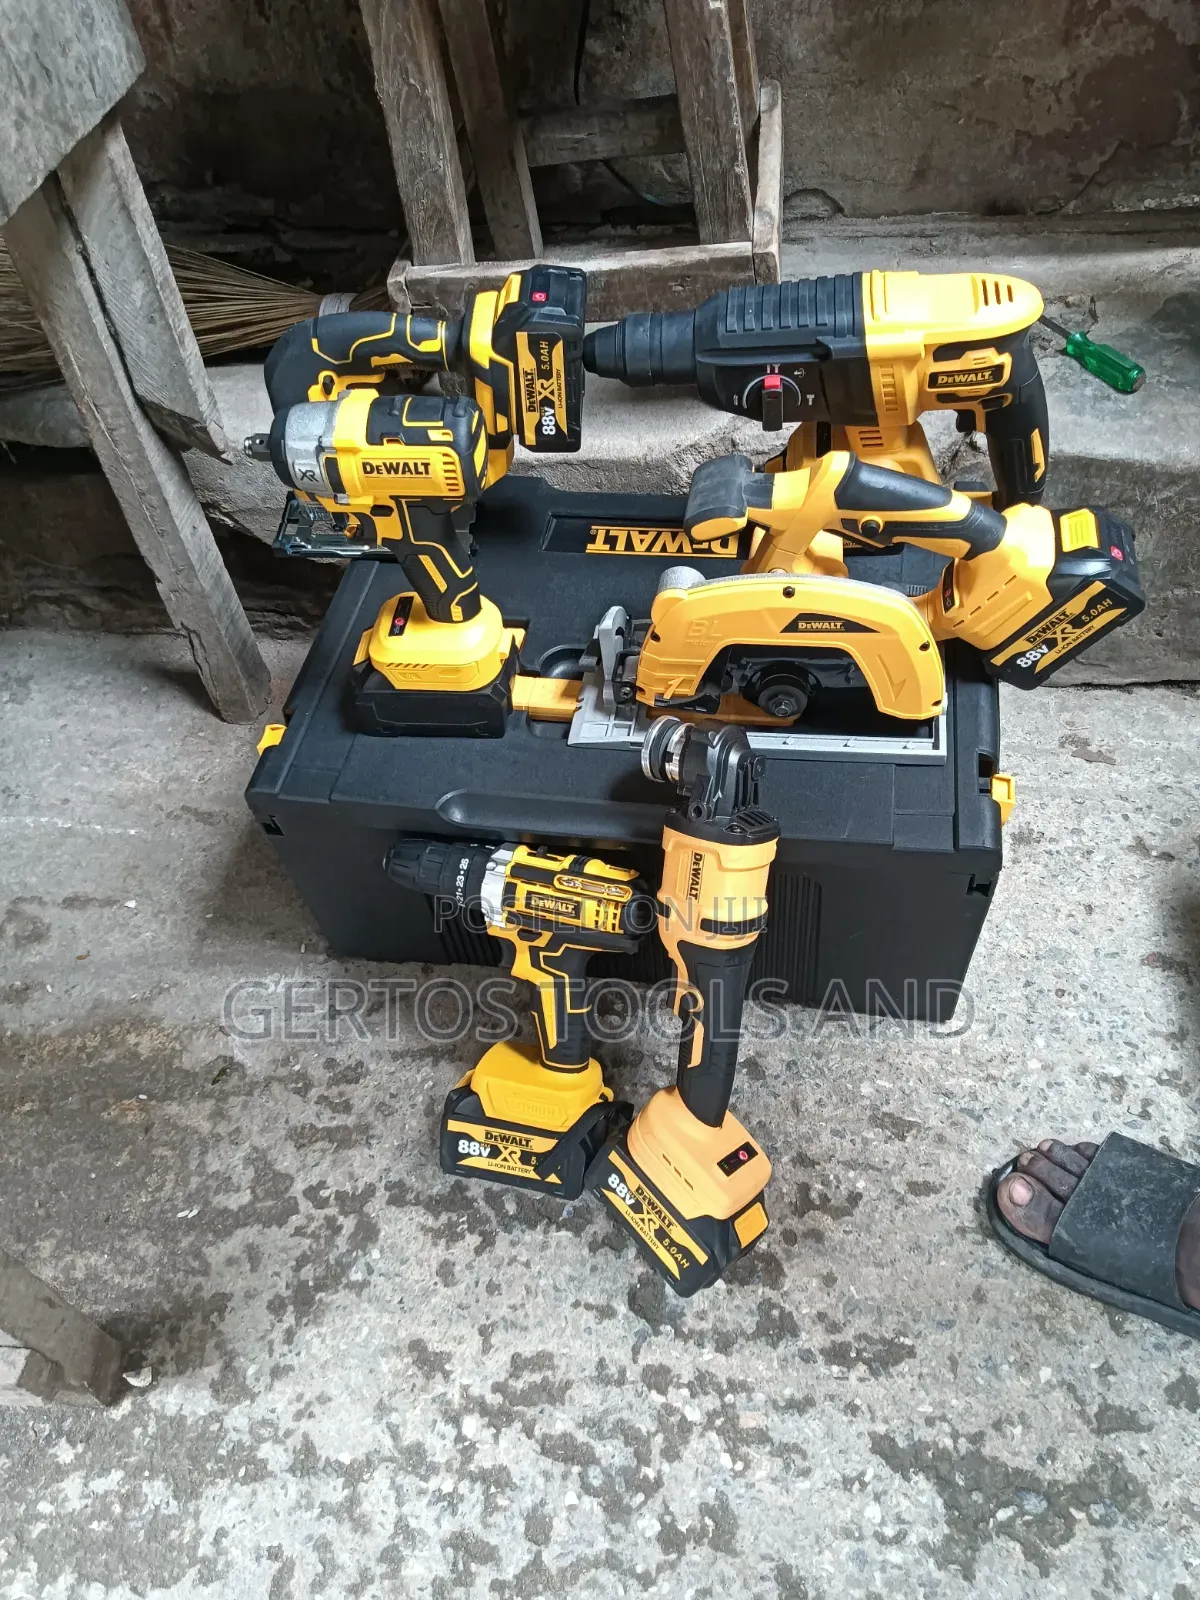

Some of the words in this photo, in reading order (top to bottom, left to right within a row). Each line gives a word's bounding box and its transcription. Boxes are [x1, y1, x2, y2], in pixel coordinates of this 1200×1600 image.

[540, 341, 550, 370] 5.0AH
[537, 378, 555, 401] XR
[298, 468, 319, 482] XR
[361, 461, 431, 475] DEWALT
[1081, 598, 1113, 622] 5.0AH
[1072, 624, 1095, 645] BATTERY
[688, 851, 703, 901] DEWALT
[484, 1131, 534, 1148] DEWALT
[496, 1145, 522, 1165] XR
[506, 1165, 532, 1174] BATTERY
[635, 1207, 660, 1237] XR
[639, 1226, 660, 1250] BATTERY
[663, 1238, 690, 1268] 5.0AH
